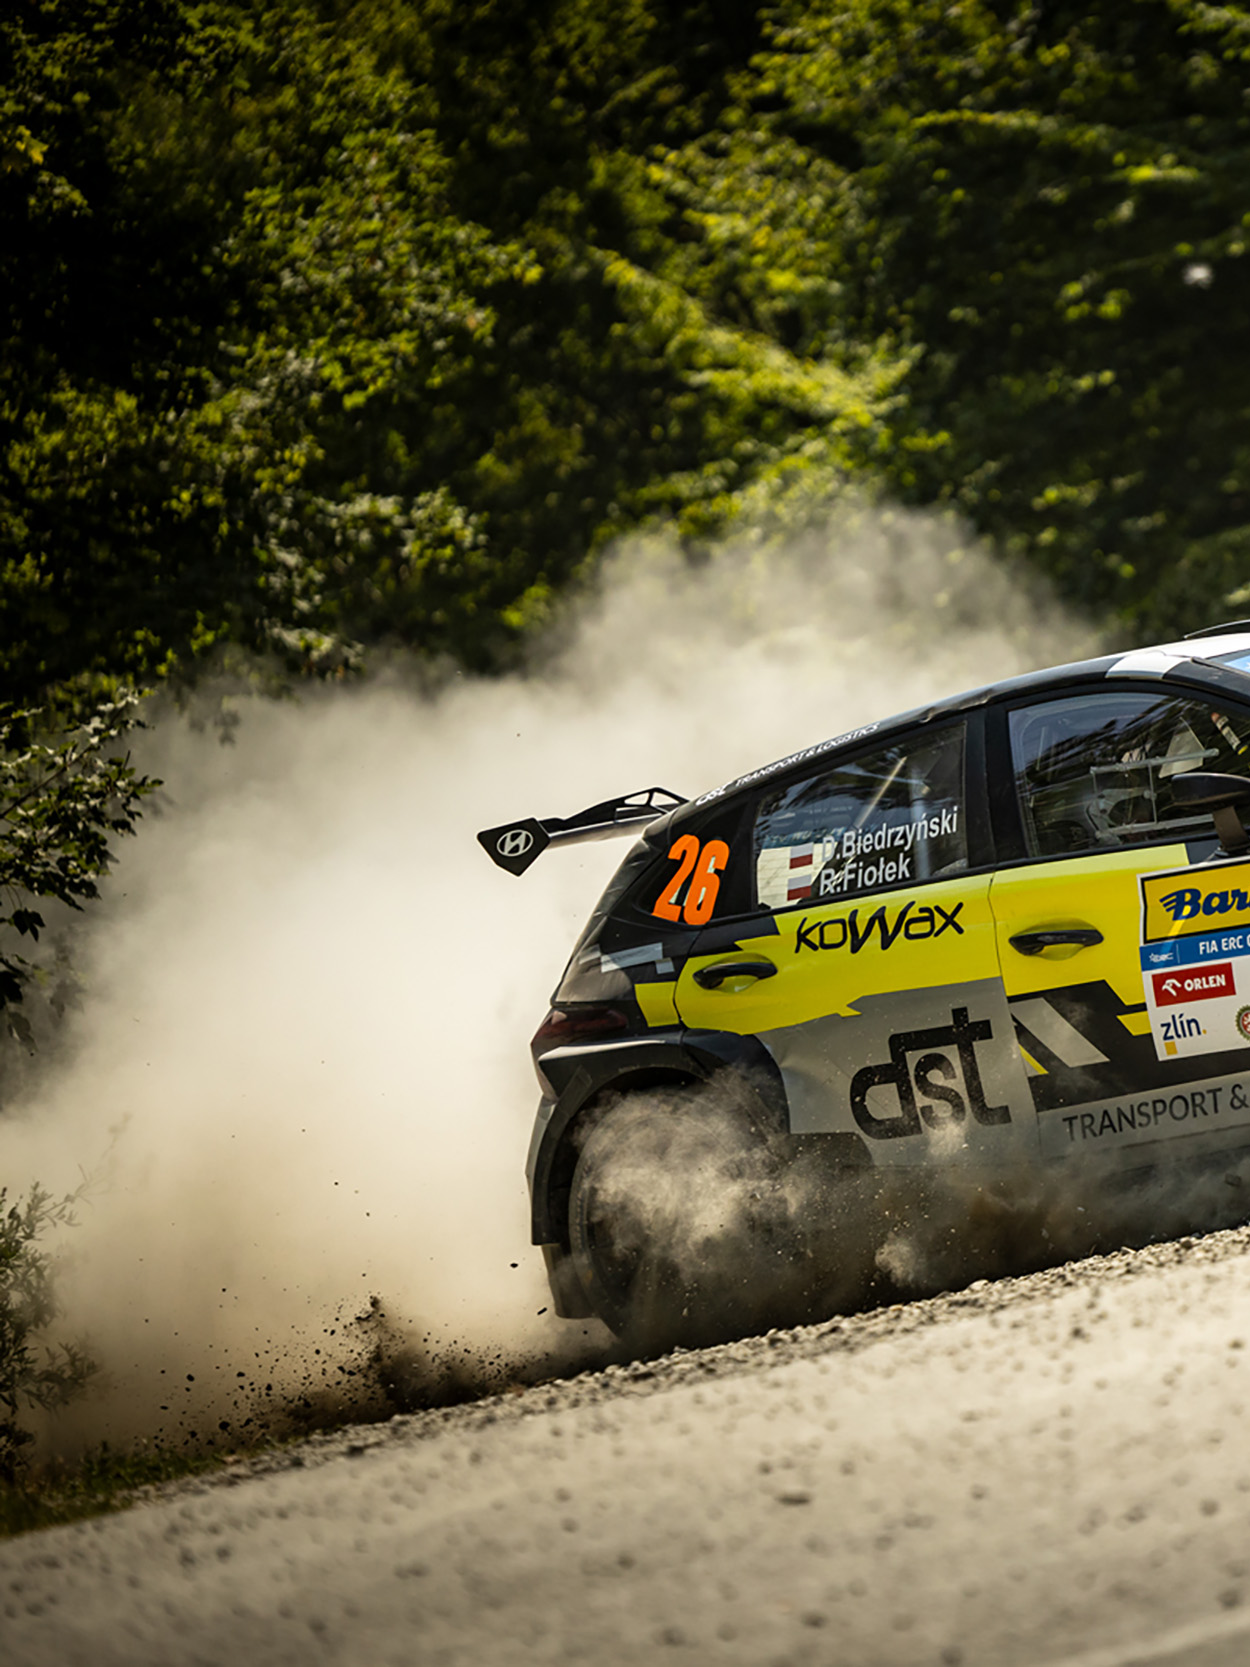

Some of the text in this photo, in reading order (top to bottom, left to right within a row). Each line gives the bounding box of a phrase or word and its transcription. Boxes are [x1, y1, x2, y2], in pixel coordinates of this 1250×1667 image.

[821, 805, 958, 862] D.Biedrzyński
[652, 834, 730, 925] 26
[818, 852, 912, 896] R.Fiołek
[1199, 940, 1219, 955] FIA
[1221, 935, 1244, 951] ERC
[1184, 974, 1226, 992] ORLEN
[850, 1006, 1012, 1141] dst
[1062, 1087, 1222, 1142] TRANSPORT
[1230, 1083, 1248, 1111] &
